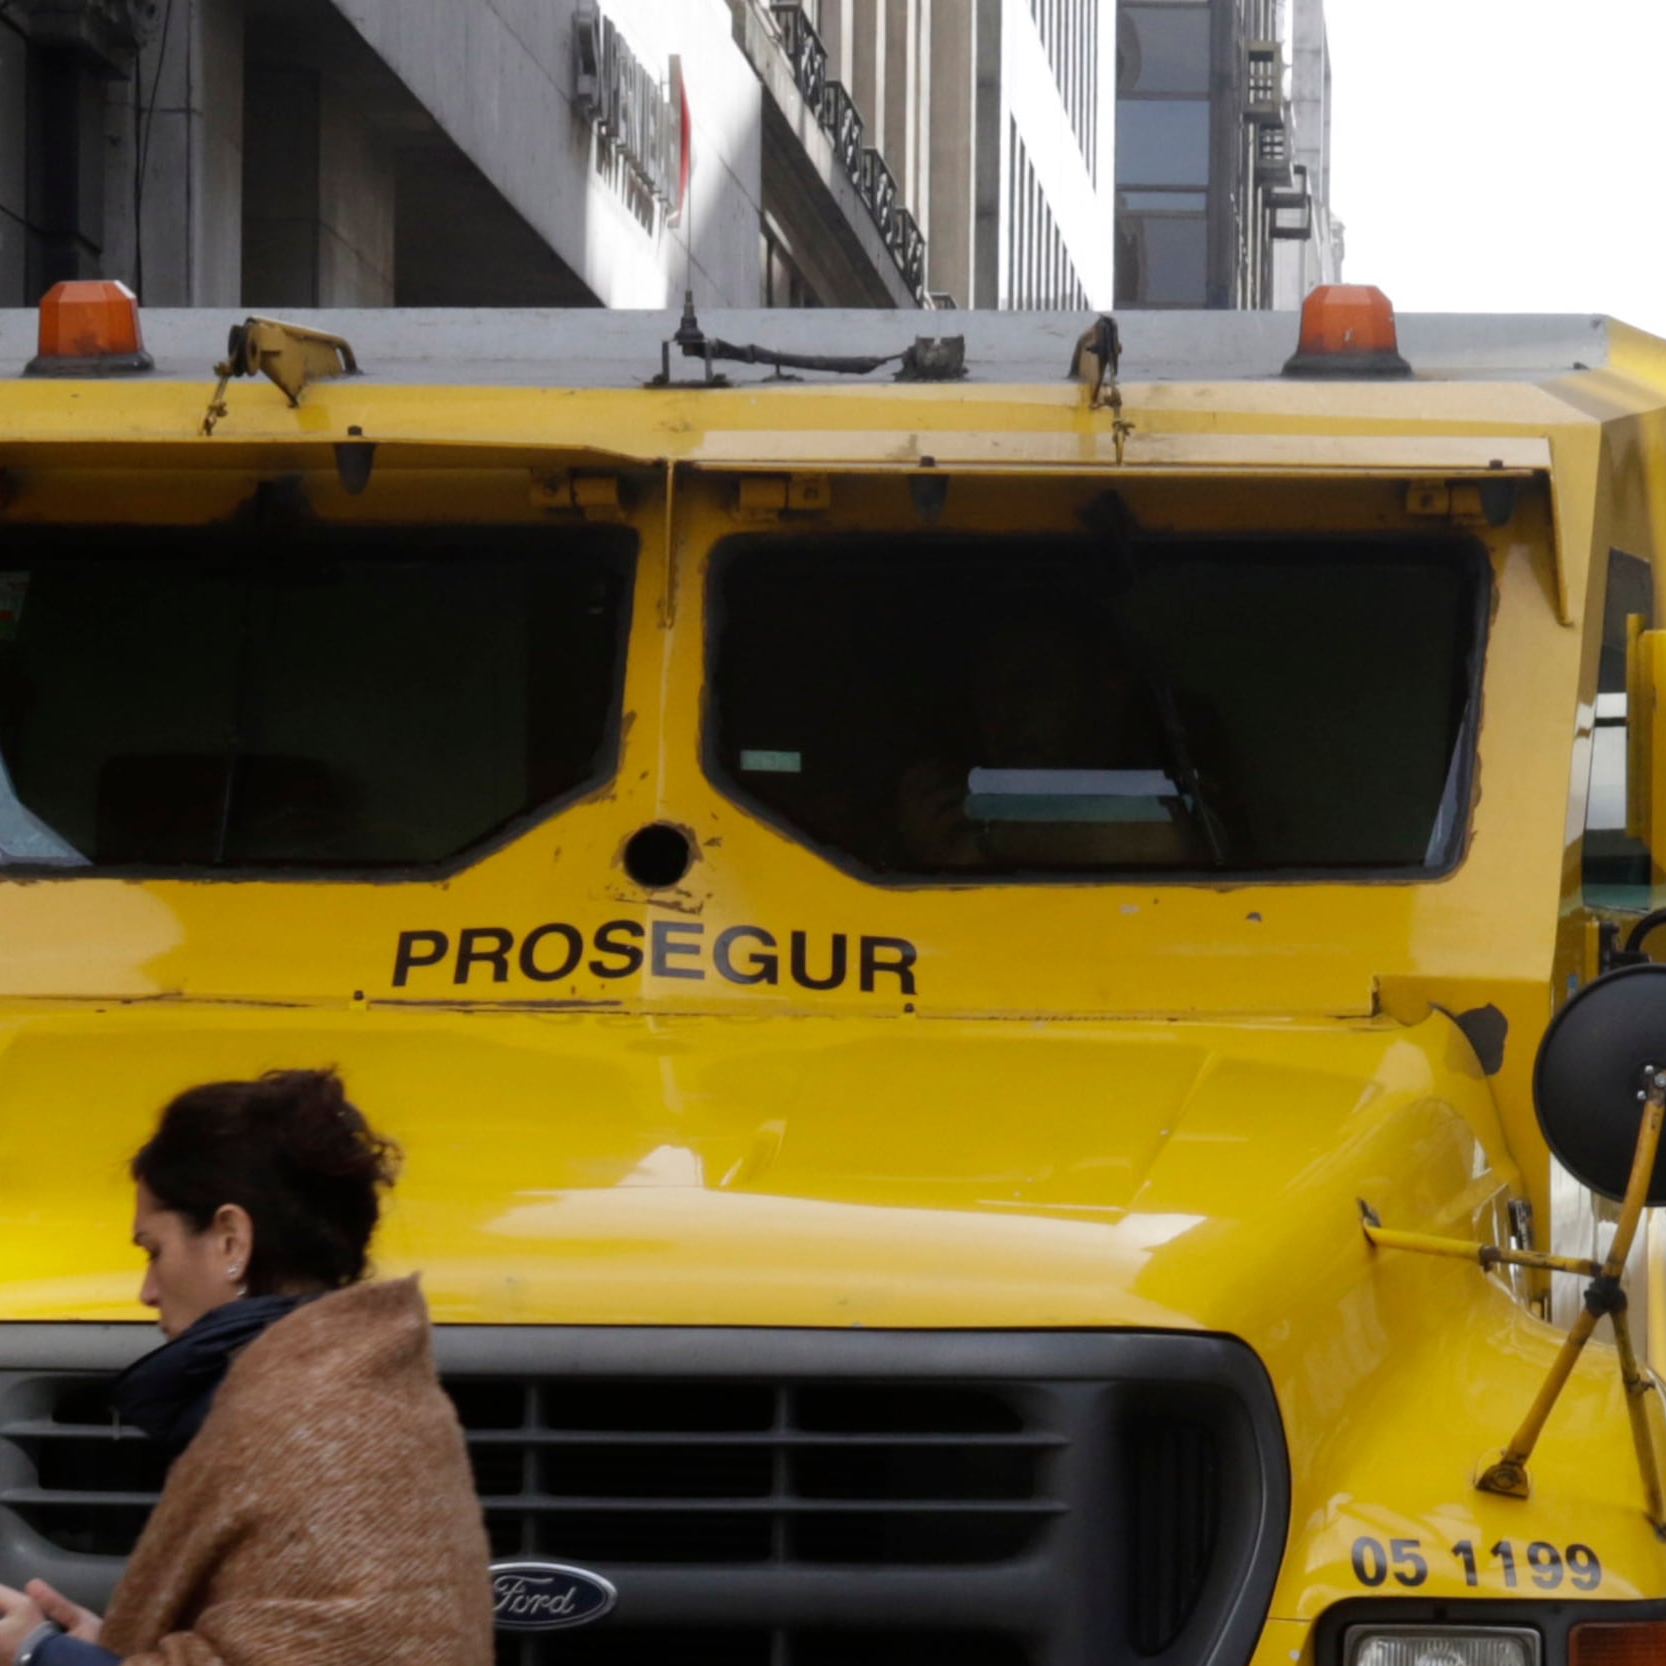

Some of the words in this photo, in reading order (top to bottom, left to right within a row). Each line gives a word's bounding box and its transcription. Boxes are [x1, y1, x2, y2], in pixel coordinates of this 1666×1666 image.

[391, 919, 919, 995] PROSEGUR
[1351, 1536, 1429, 1588] 05
[1450, 1539, 1603, 1592] 1199
[493, 1574, 578, 1615] Ford
